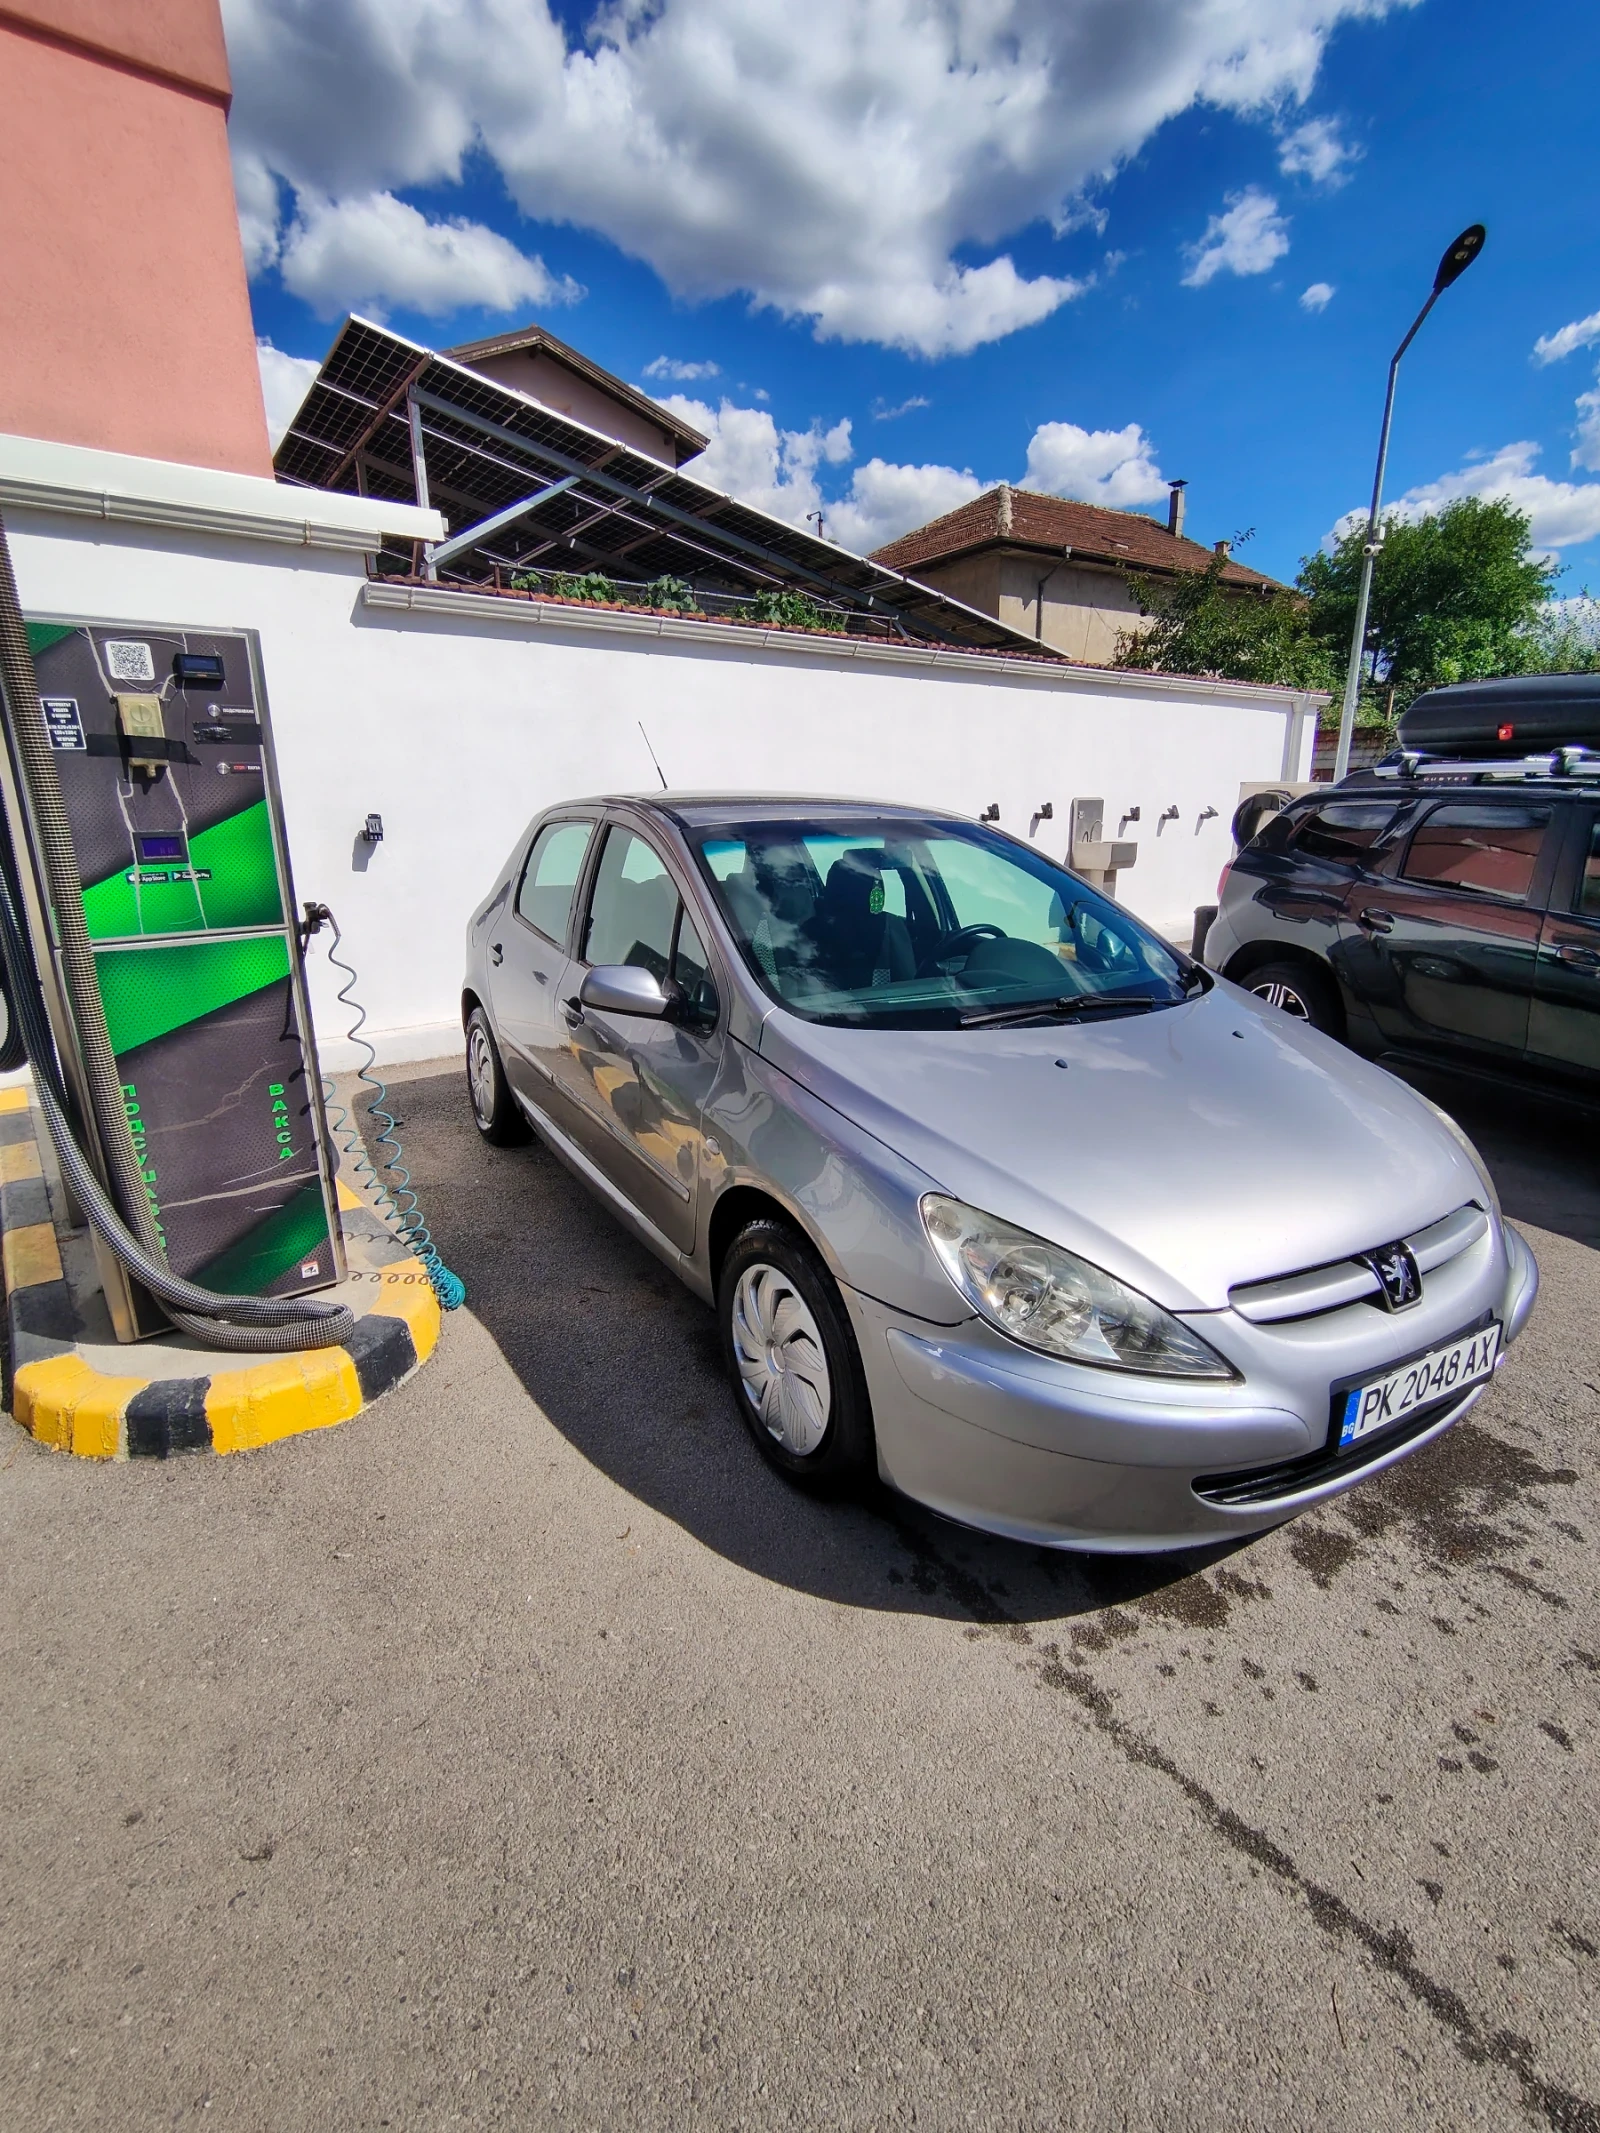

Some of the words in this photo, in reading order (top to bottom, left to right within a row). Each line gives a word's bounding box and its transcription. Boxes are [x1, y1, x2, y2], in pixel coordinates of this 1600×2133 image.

[268, 1083, 294, 1160] ВАКСА
[1398, 1349, 1461, 1412] 2048
[1341, 1422, 1355, 1438] BG
